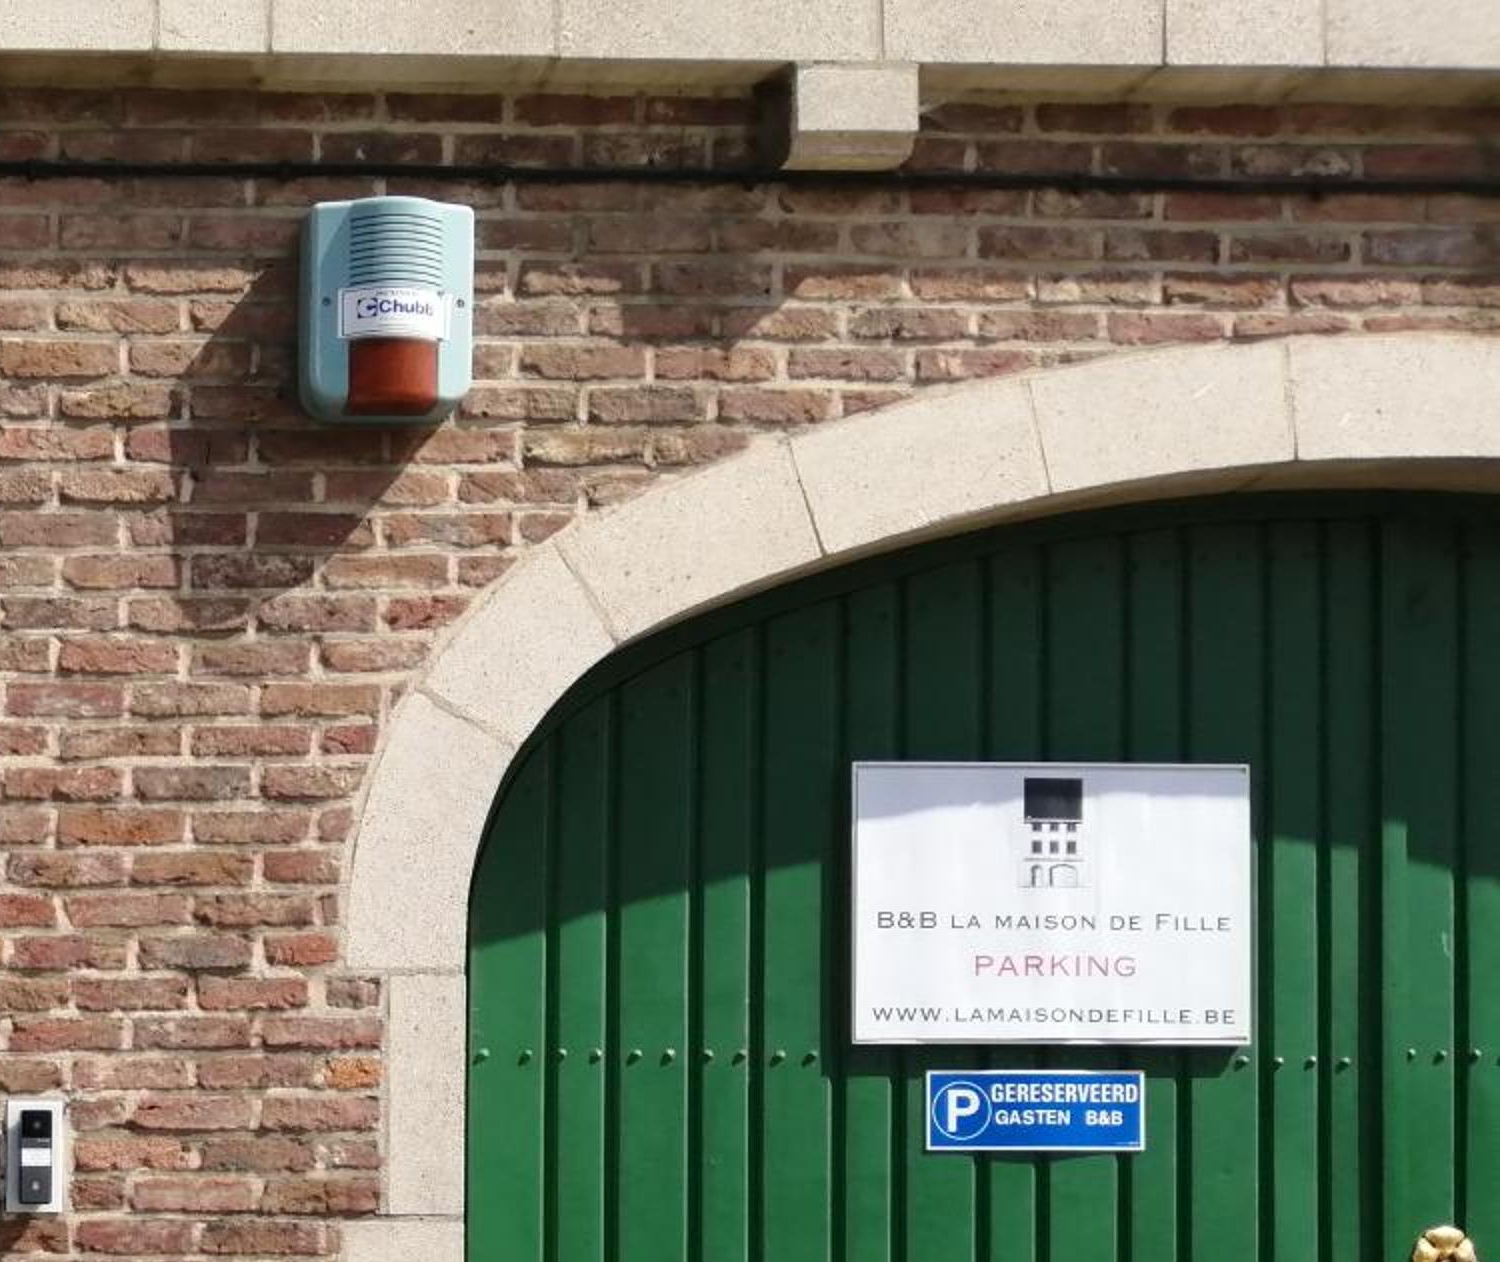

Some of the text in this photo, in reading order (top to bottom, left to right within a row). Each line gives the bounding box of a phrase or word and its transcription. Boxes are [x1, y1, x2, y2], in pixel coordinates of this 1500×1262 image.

[378, 299, 435, 316] Chubb
[876, 910, 938, 929] B&B
[950, 912, 981, 930] LA
[994, 914, 1097, 931] MAISON
[1109, 914, 1142, 931] DE
[974, 954, 1137, 978] PARKING
[872, 1006, 1236, 1025] WWW.LAMAISONDEFILLE.BE
[991, 1083, 1138, 1103] GERESERVEERD
[947, 1089, 980, 1133] P
[995, 1109, 1123, 1126] GASTEN B&B
